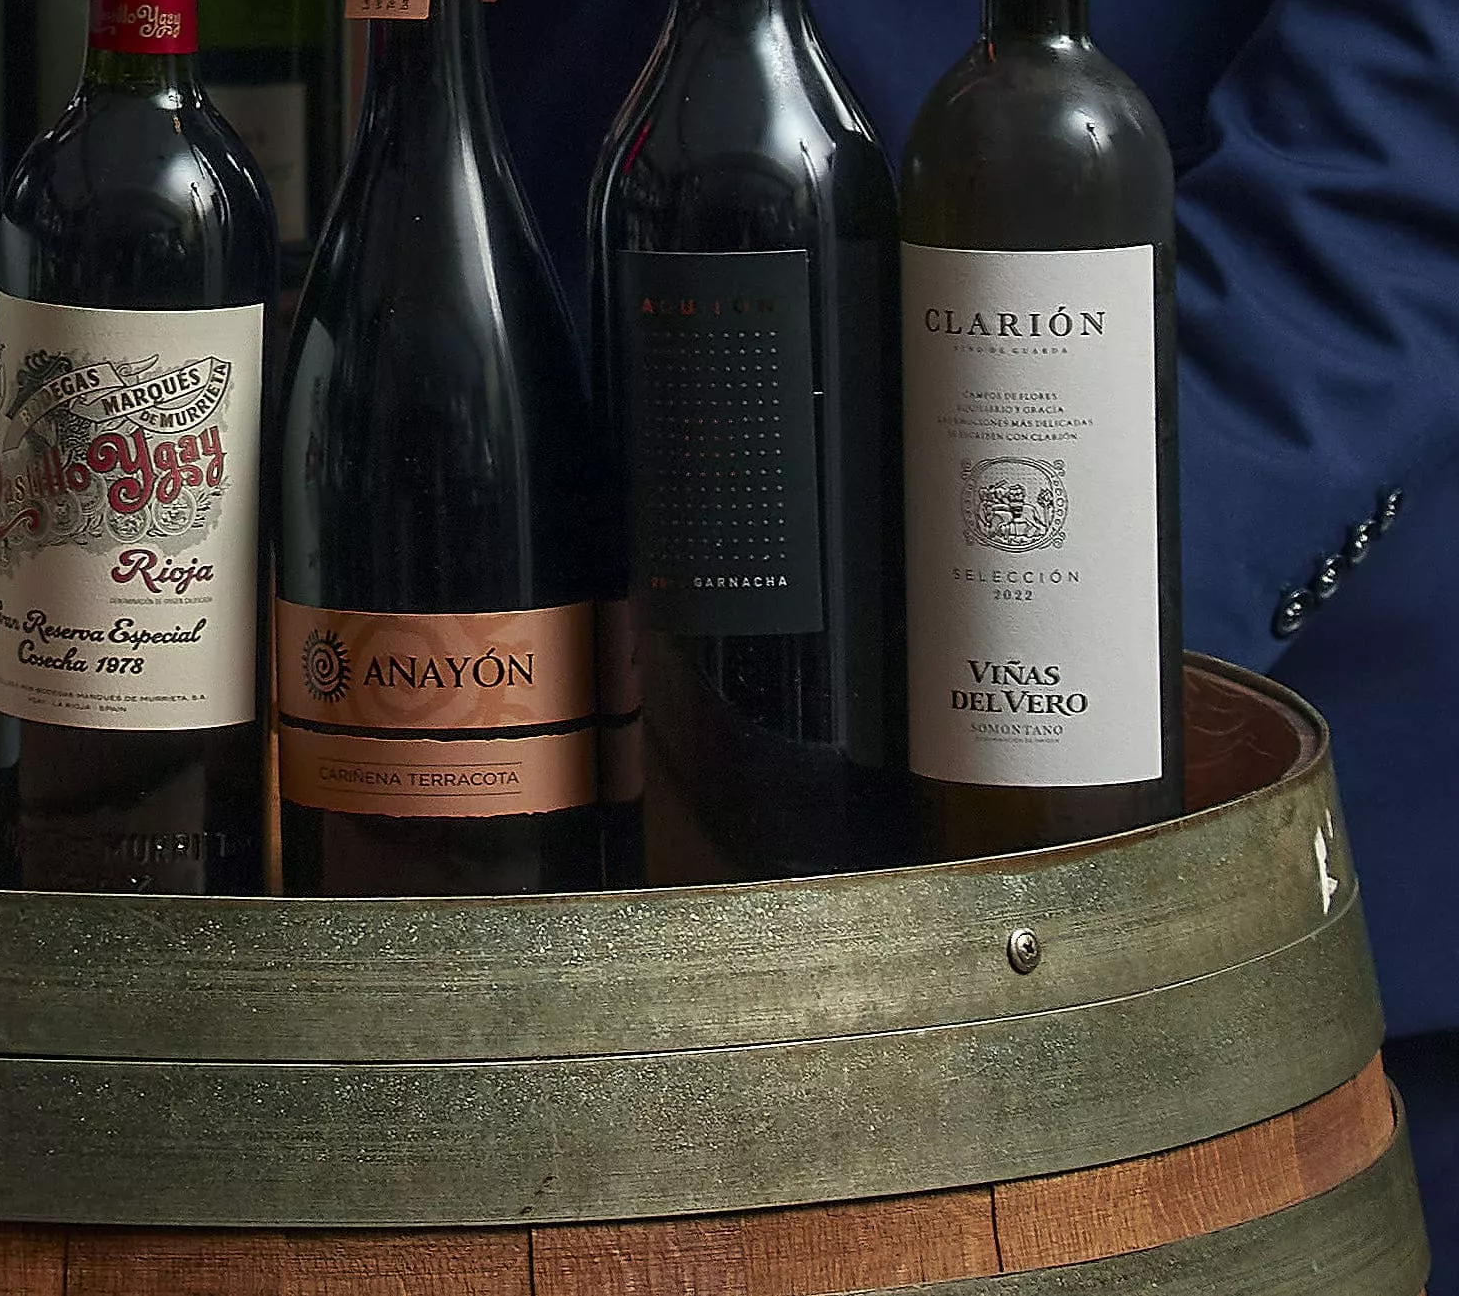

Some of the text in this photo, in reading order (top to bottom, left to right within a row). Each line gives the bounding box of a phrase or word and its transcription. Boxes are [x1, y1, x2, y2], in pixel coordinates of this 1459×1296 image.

[924, 306, 1106, 337] CLARIÓN
[20, 368, 101, 426] BDEGAS
[139, 363, 231, 428] DE MURRIETA
[1006, 433, 1029, 442] CON
[87, 425, 228, 514] Ygay
[110, 548, 215, 595] Rioja
[693, 576, 789, 589] GARNACHA
[952, 567, 1081, 584] SELECCIÓN
[993, 589, 1034, 601] 2022
[22, 609, 105, 644] Reserva
[107, 617, 208, 650] Especial
[17, 638, 146, 675] Cosecha 1978
[363, 648, 535, 689] ANAYÓN
[966, 659, 1061, 686] VIÑAS
[950, 689, 1090, 716] DEL VERO
[970, 724, 1064, 736] SOMONTANO
[318, 766, 520, 788] CARIÑENA TERRACOTA
